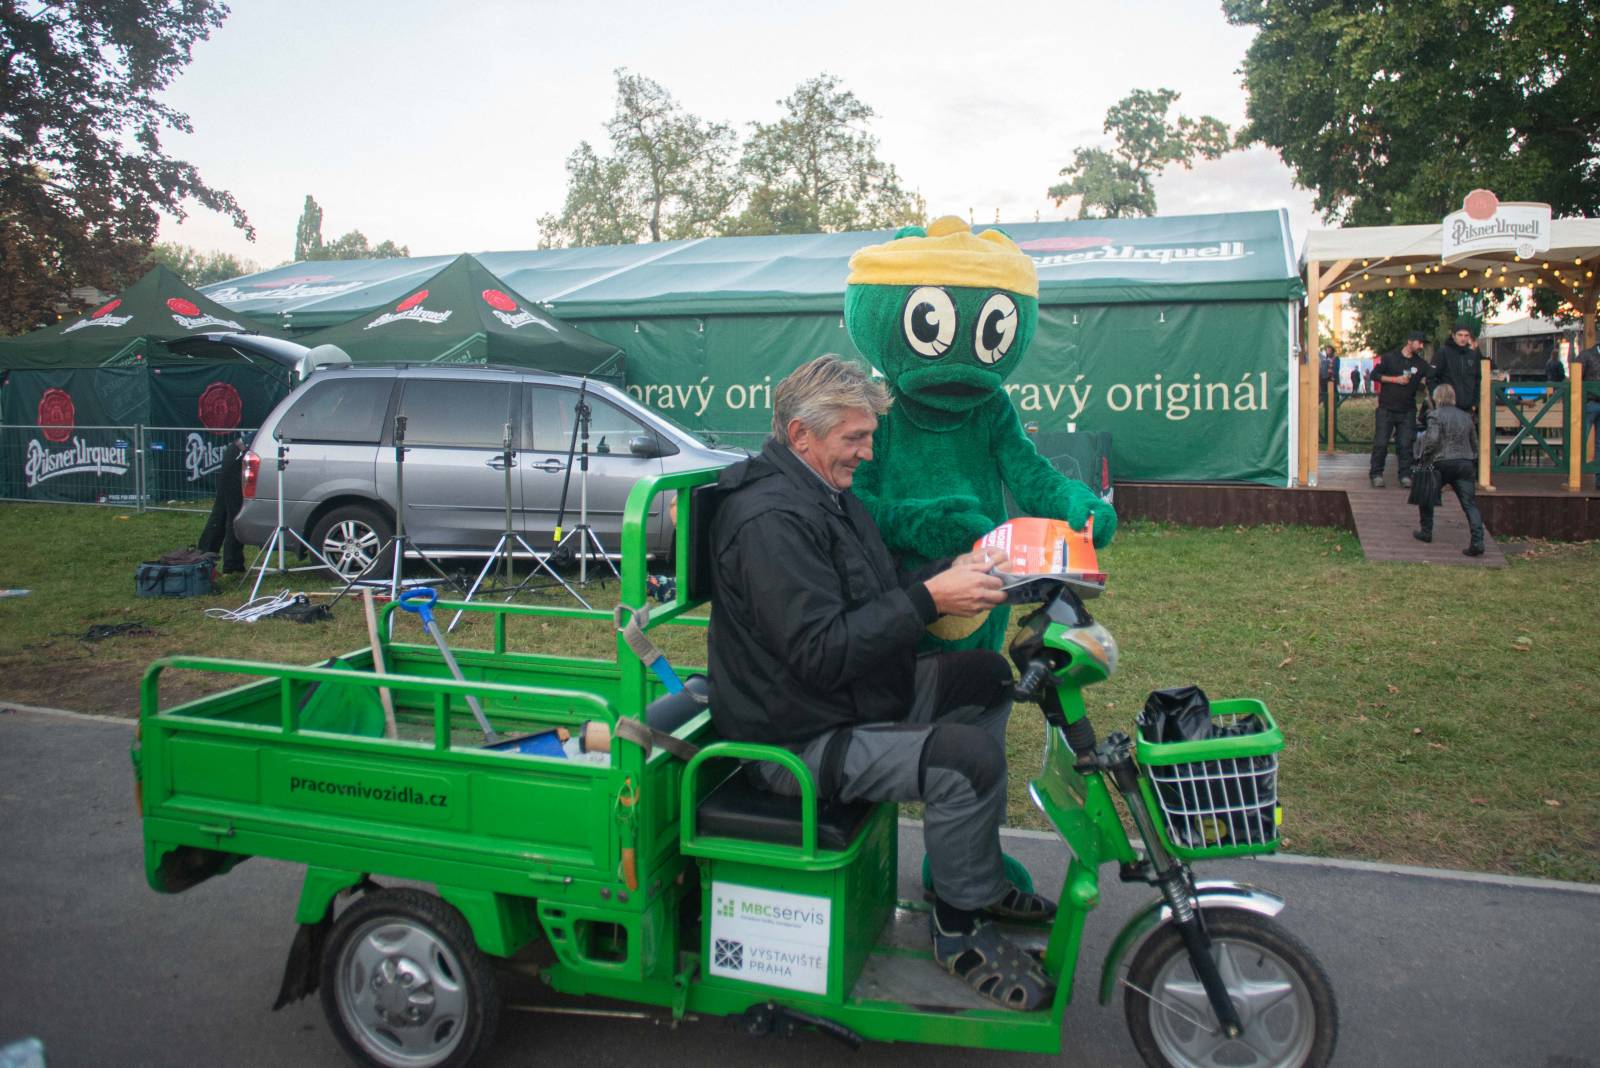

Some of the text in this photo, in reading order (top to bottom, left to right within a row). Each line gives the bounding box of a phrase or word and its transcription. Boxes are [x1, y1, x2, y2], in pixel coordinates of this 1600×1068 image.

[1452, 218, 1539, 246] Pilsner Urquell
[1102, 241, 1245, 265] Urquell
[1106, 371, 1269, 420] originál
[25, 436, 127, 487] Pilsner Urquell
[290, 776, 448, 807] pracovnivozidla.cz
[740, 902, 824, 925] MBCservis
[749, 960, 792, 977] PRAHA
